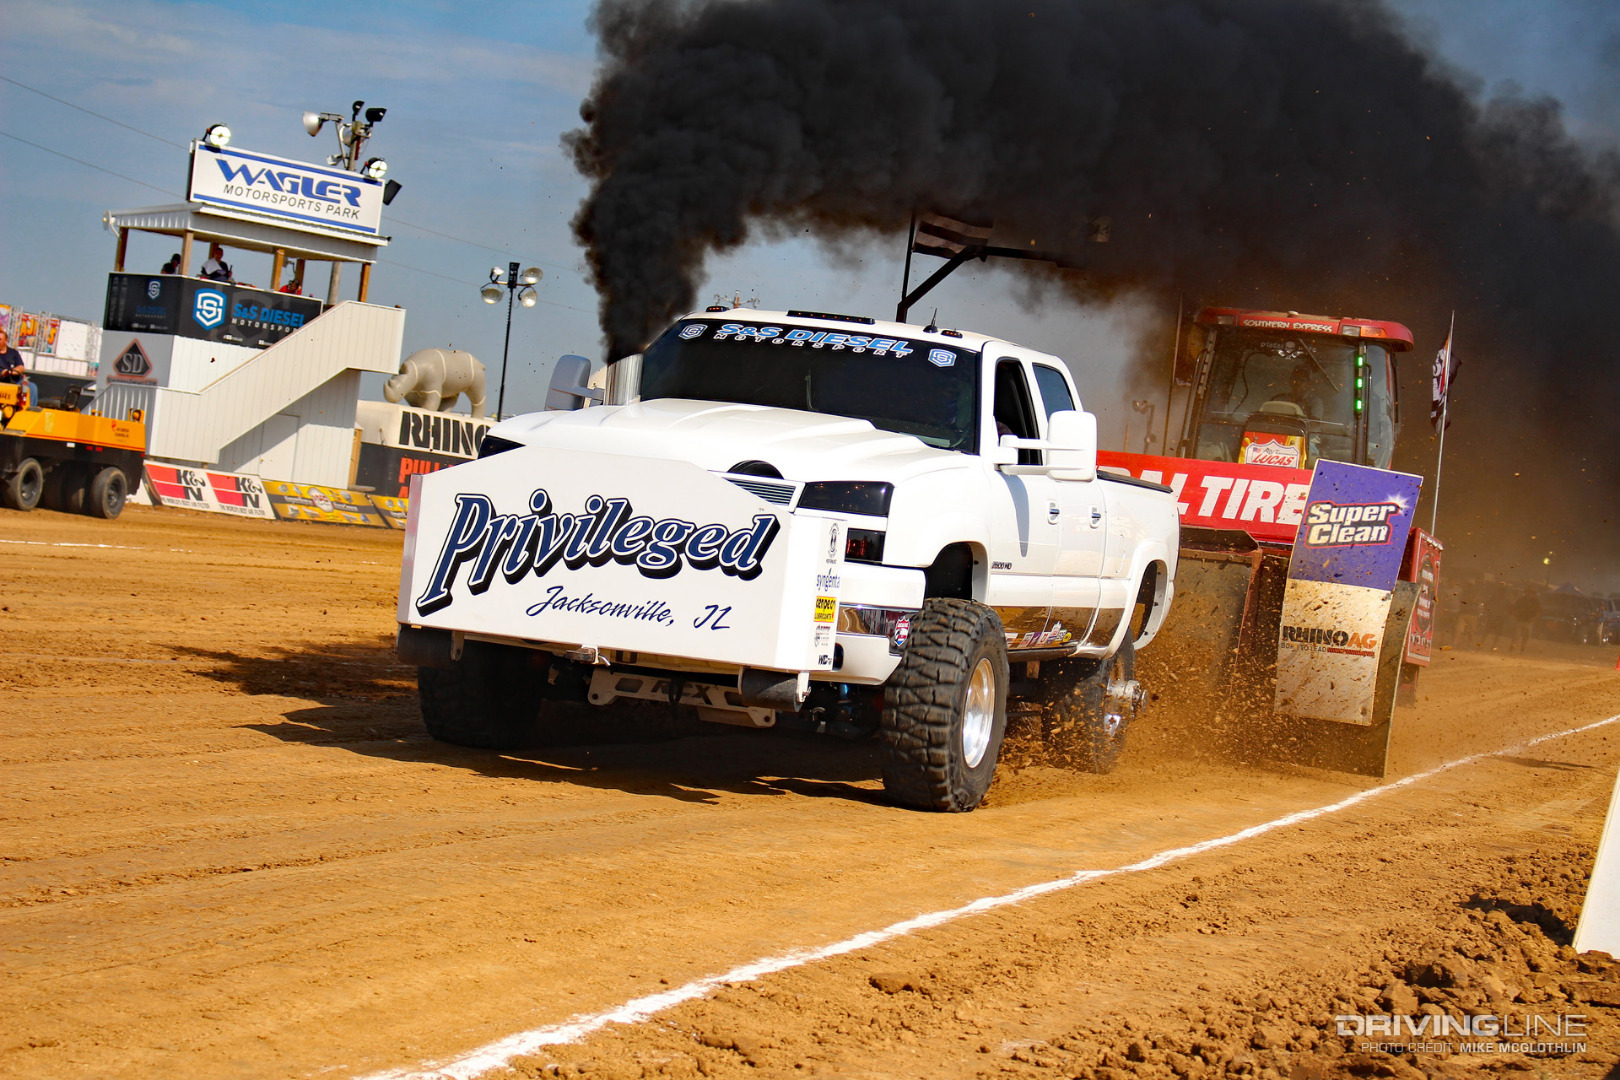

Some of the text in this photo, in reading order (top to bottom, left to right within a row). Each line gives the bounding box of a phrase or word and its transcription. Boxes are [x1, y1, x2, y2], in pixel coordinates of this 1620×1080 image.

[215, 158, 361, 207] WAGLER
[223, 184, 361, 220] MOTORSPORTS PARK
[233, 303, 306, 327] S&S DIESEL
[1243, 319, 1333, 333] SOUTHERN EXPRESS
[713, 333, 908, 359] MOTORSPORT
[717, 323, 914, 355] S&S DIESEL
[121, 352, 143, 374] SD
[398, 410, 491, 457] RHINO
[1252, 453, 1295, 467] LUCAS
[1308, 503, 1400, 527] Super
[1308, 523, 1389, 545] Clean
[415, 488, 781, 618] Privileged
[526, 585, 675, 627] Jacksonville,
